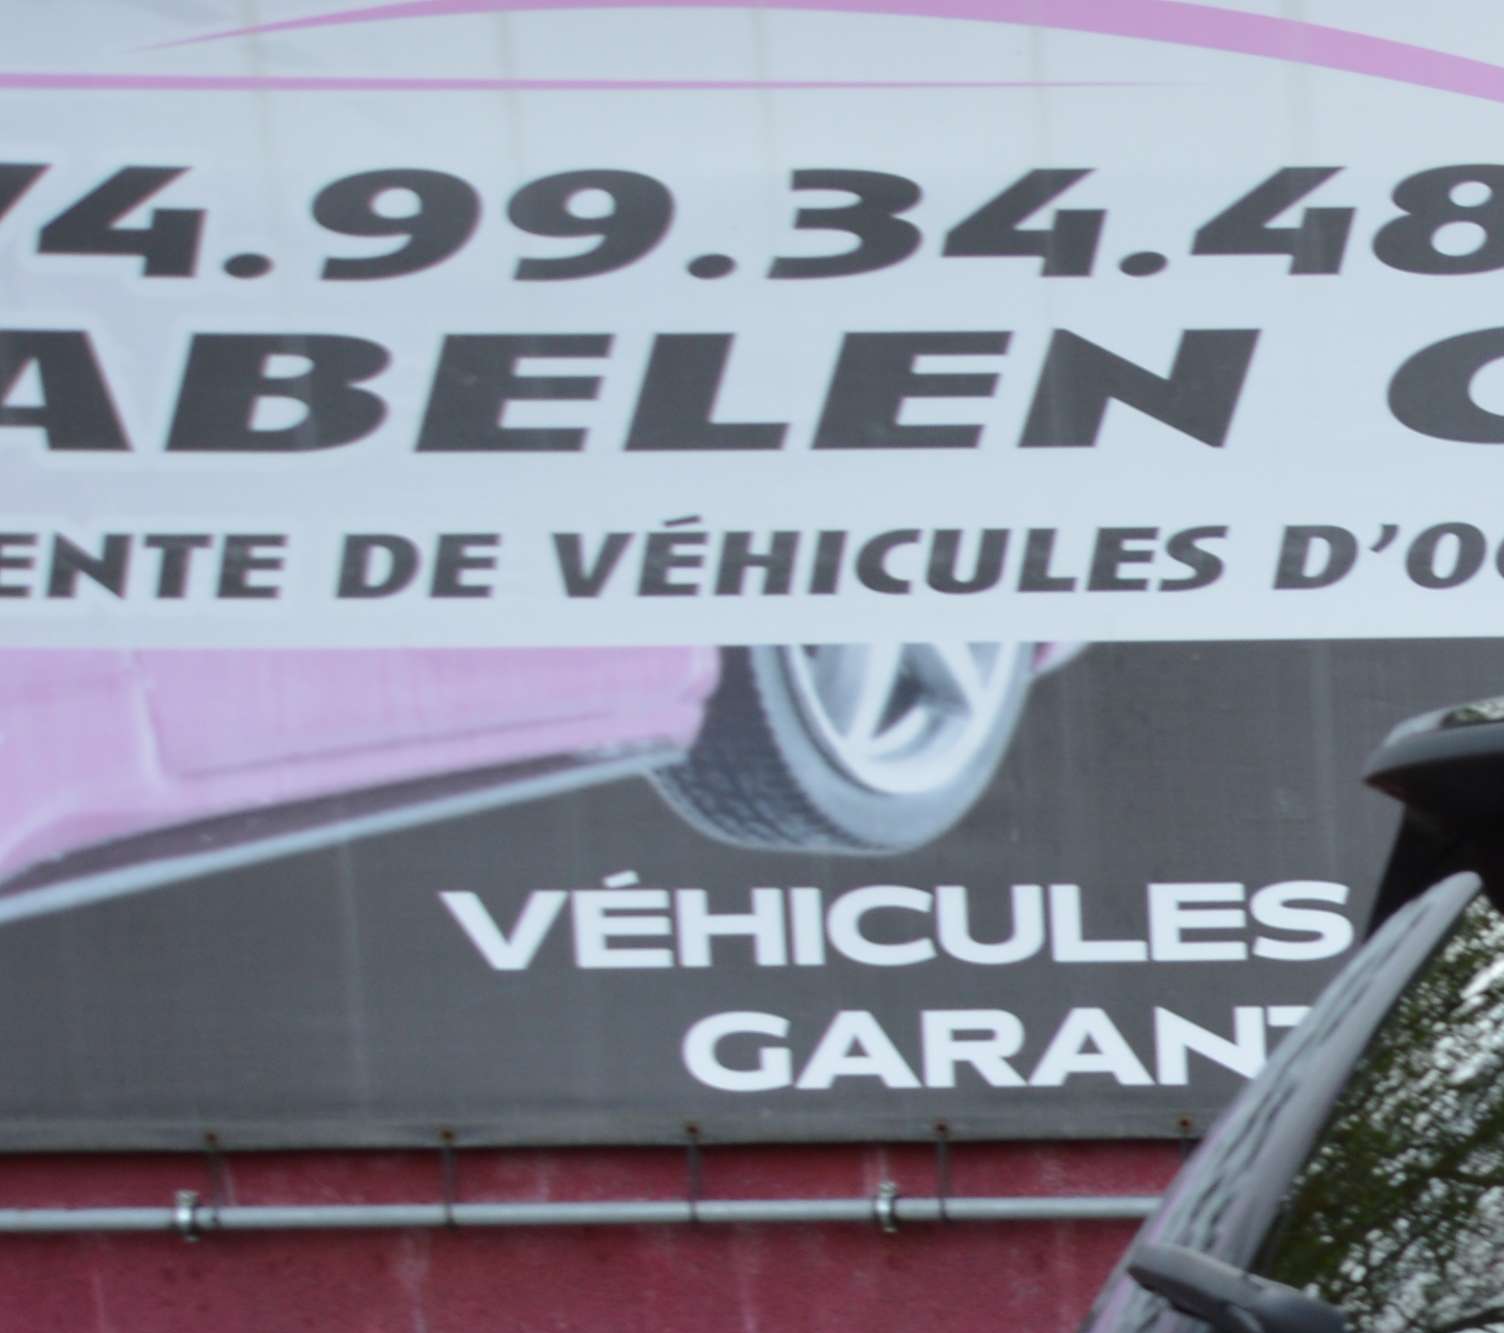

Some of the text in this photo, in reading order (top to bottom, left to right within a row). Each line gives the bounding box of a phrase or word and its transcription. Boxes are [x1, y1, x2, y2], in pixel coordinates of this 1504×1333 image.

[335, 533, 501, 599] DE
[552, 514, 1229, 598] VÉHICULES
[438, 871, 1355, 971] VÉHICULES
